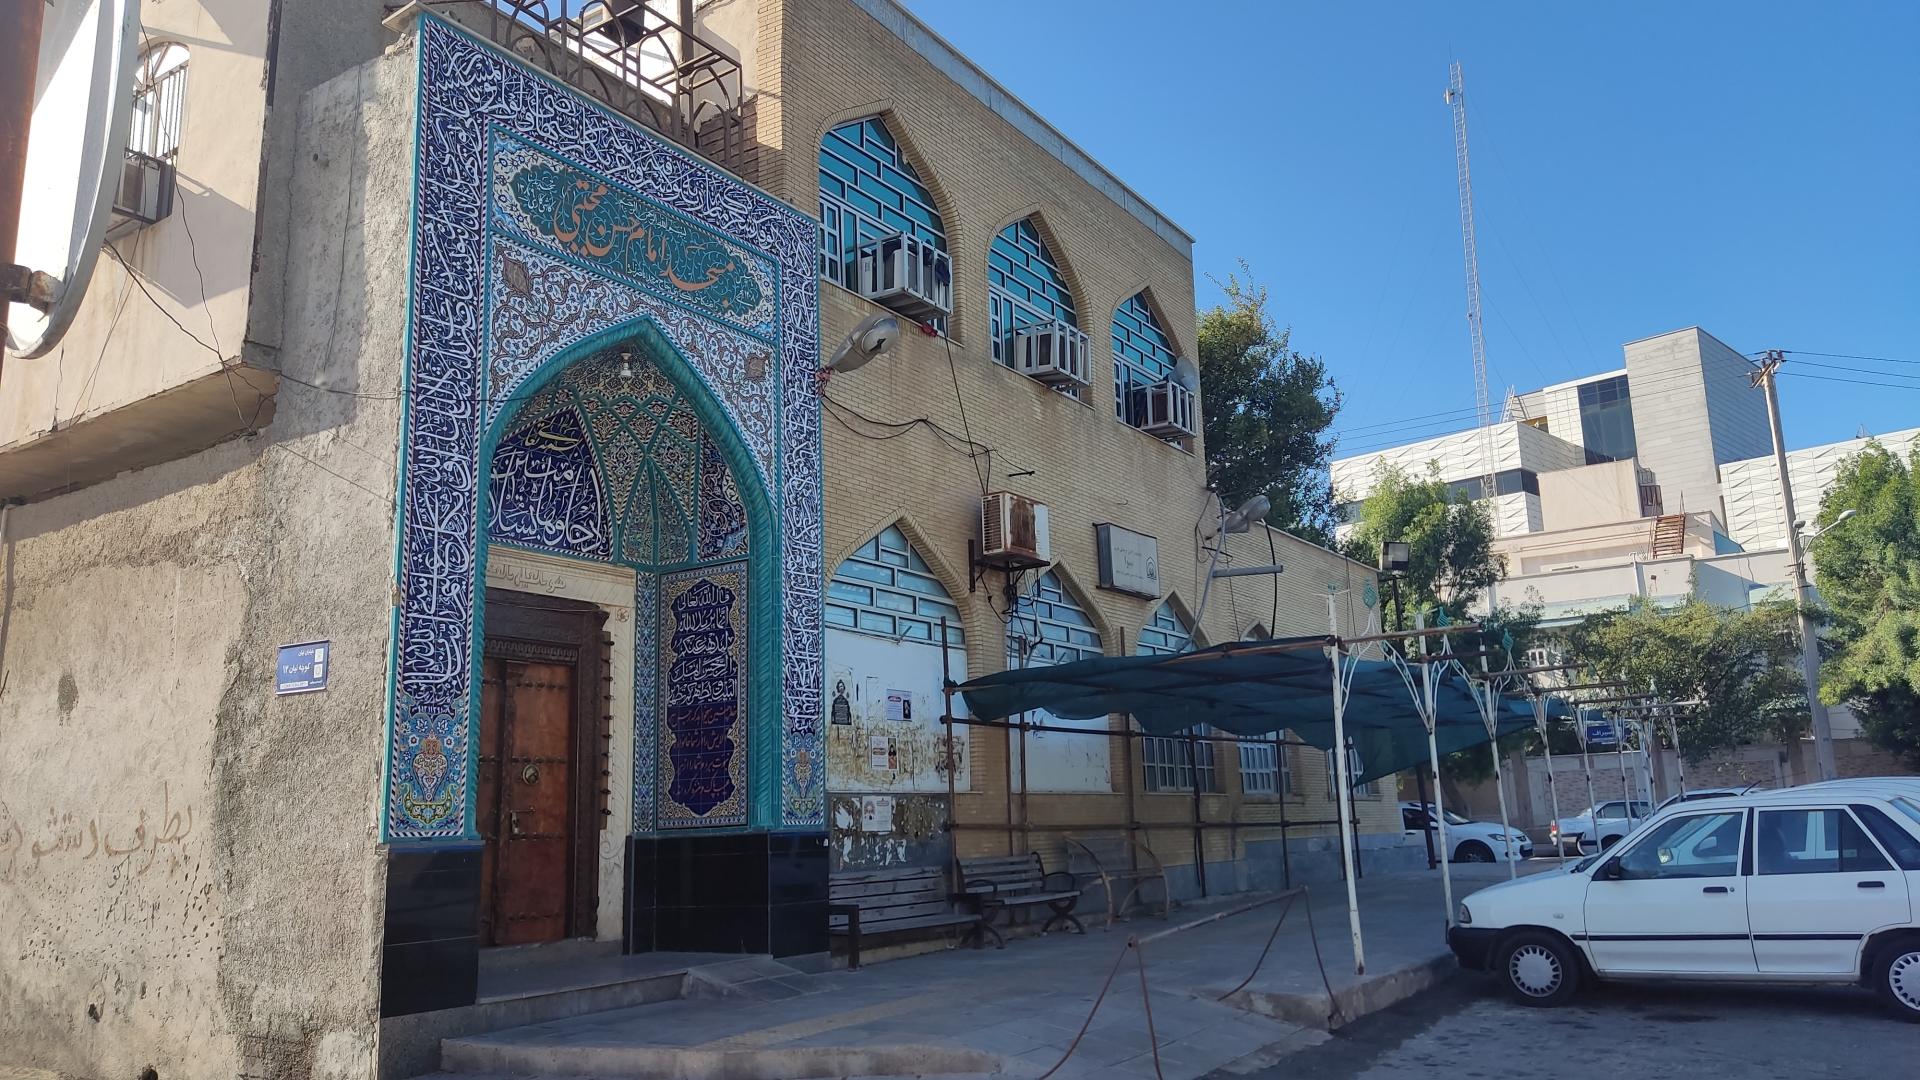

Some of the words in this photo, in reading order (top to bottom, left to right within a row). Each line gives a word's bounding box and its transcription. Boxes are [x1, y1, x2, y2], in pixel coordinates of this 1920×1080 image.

[553, 179, 610, 256] مجتبی
[584, 216, 642, 258] حسن
[626, 226, 668, 274] امام
[659, 258, 736, 308] مسجد
[298, 662, 312, 674] کوچه
